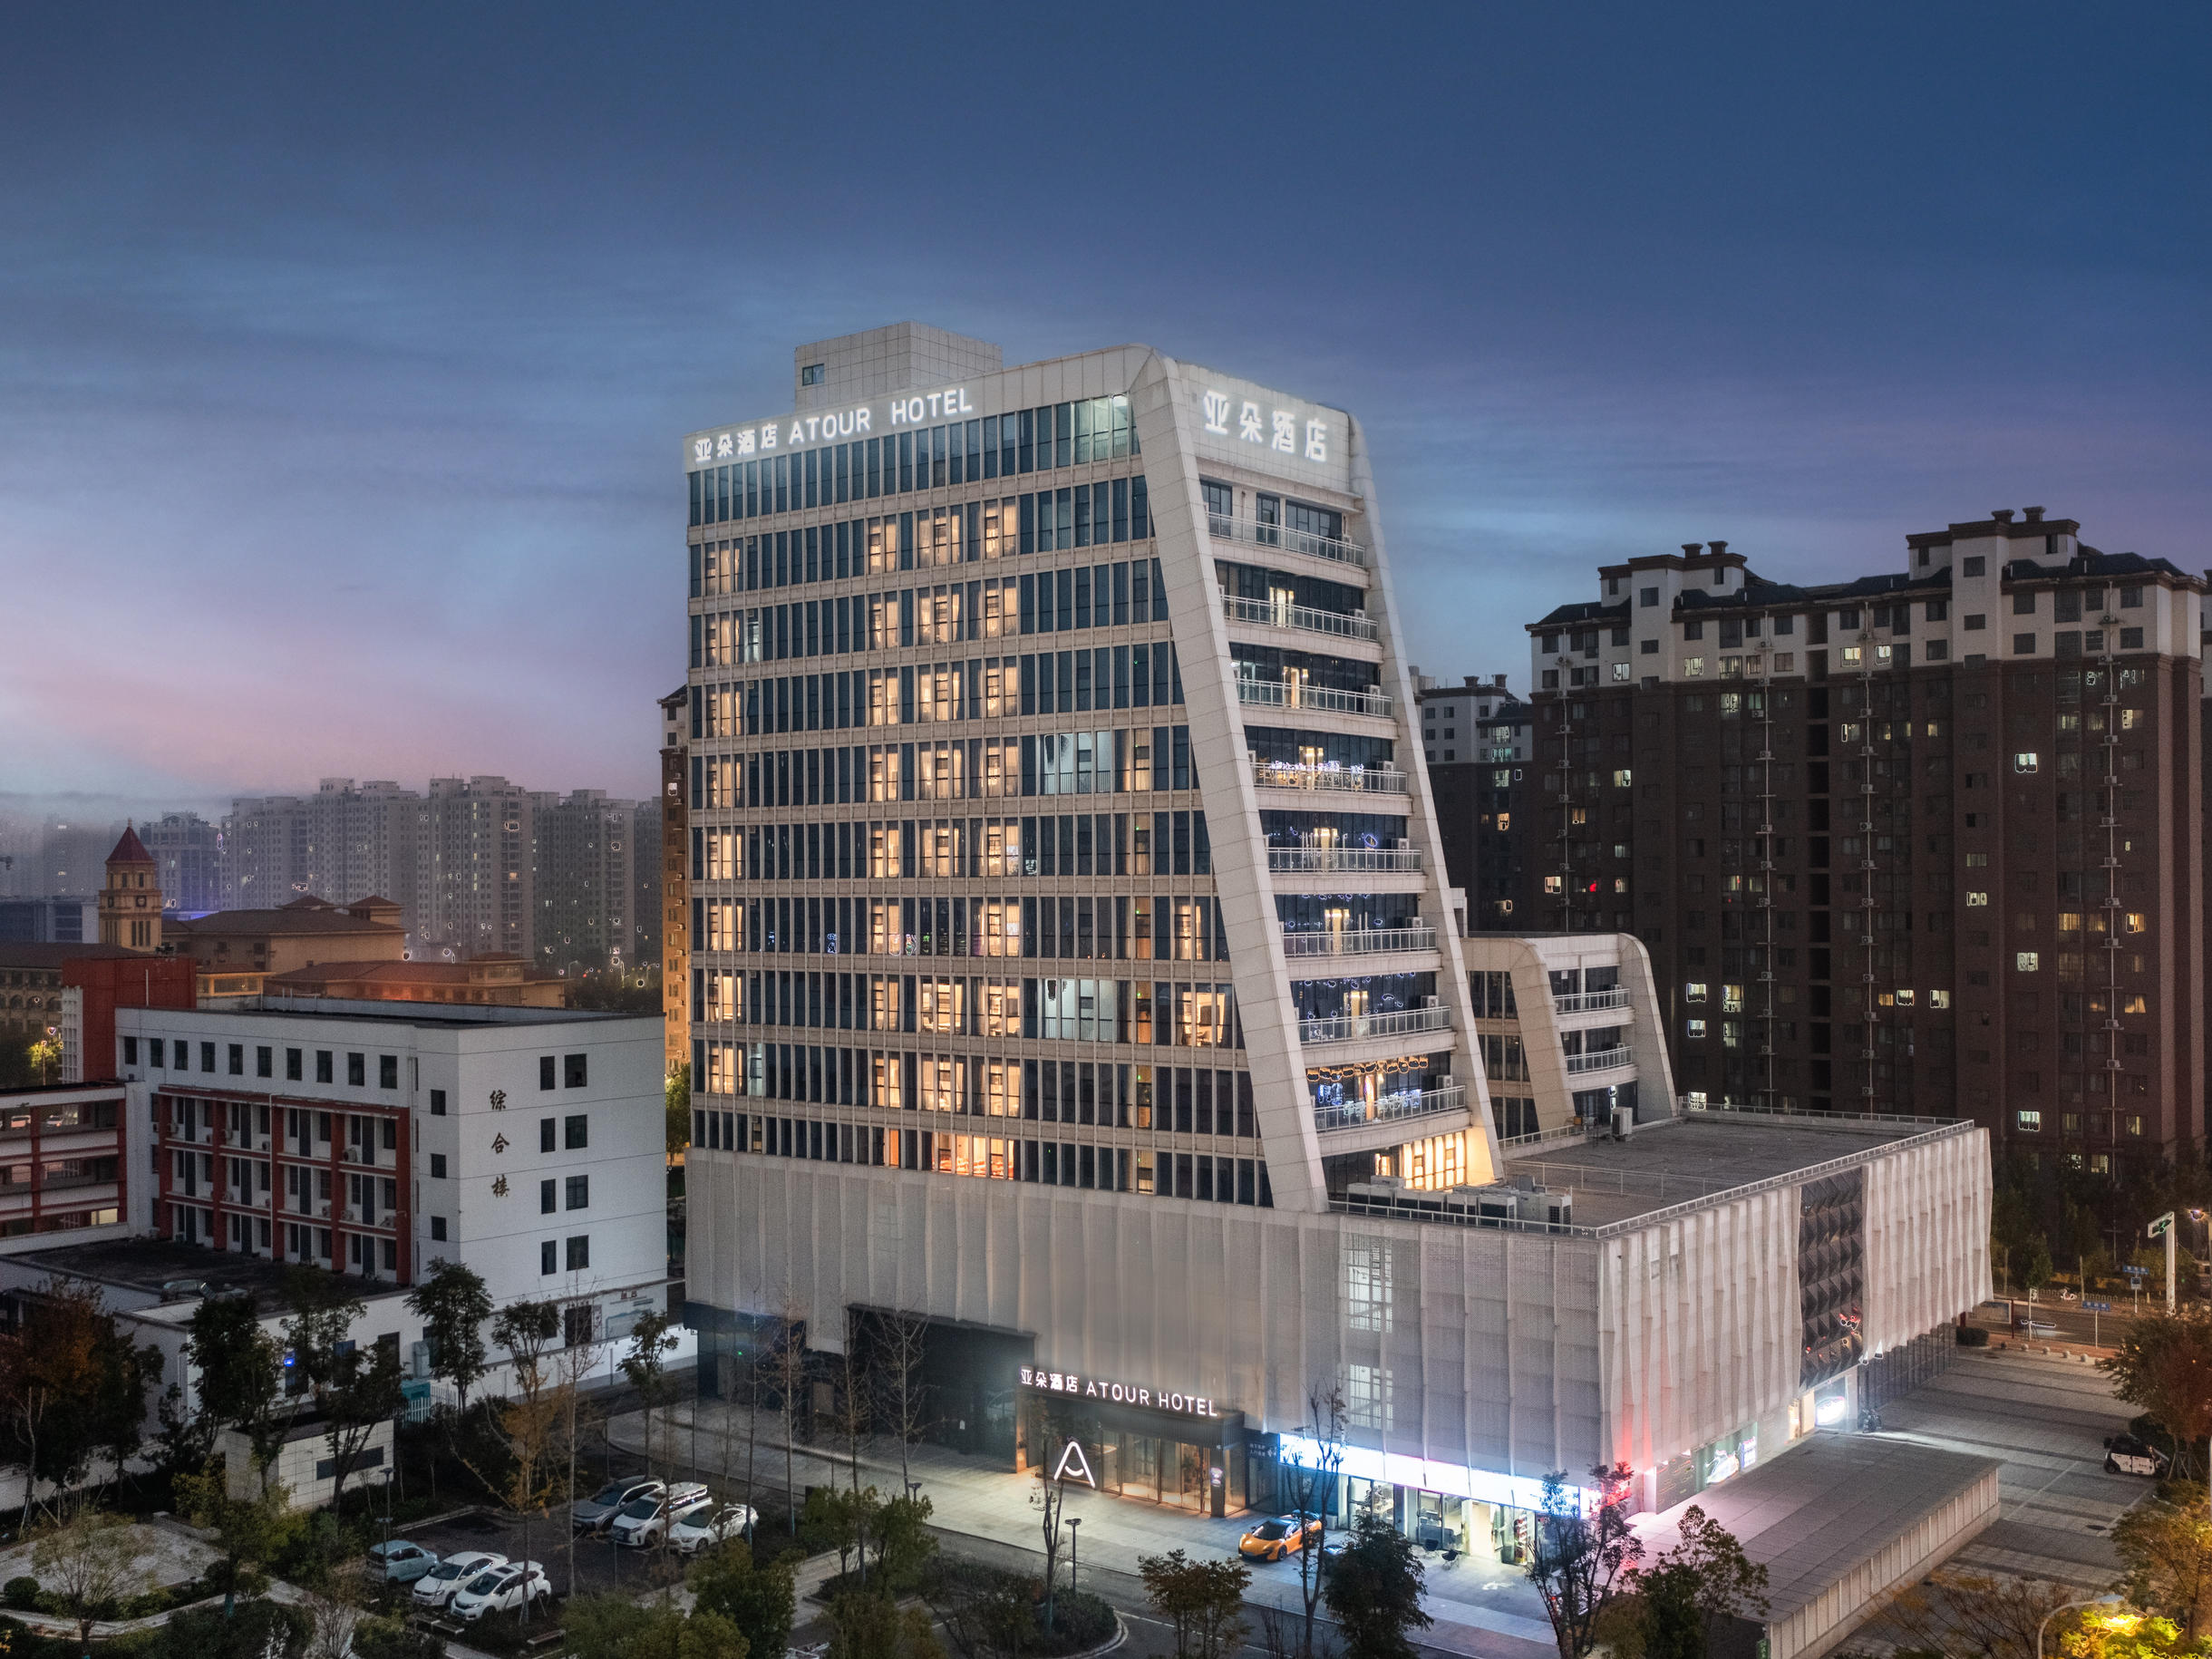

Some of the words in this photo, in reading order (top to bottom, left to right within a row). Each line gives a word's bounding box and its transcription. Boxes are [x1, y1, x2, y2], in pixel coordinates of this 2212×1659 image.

[694, 422, 777, 461] 亚朵酒店
[789, 407, 870, 444] ATOUR
[891, 388, 973, 425] HOTEL
[1203, 390, 1327, 462] 亚朵酒店
[490, 1090, 509, 1197] 综合楼
[1020, 1369, 1079, 1392] 亚朵酒店
[1086, 1380, 1150, 1405] ATOUR
[1159, 1392, 1218, 1417] HOTEL
